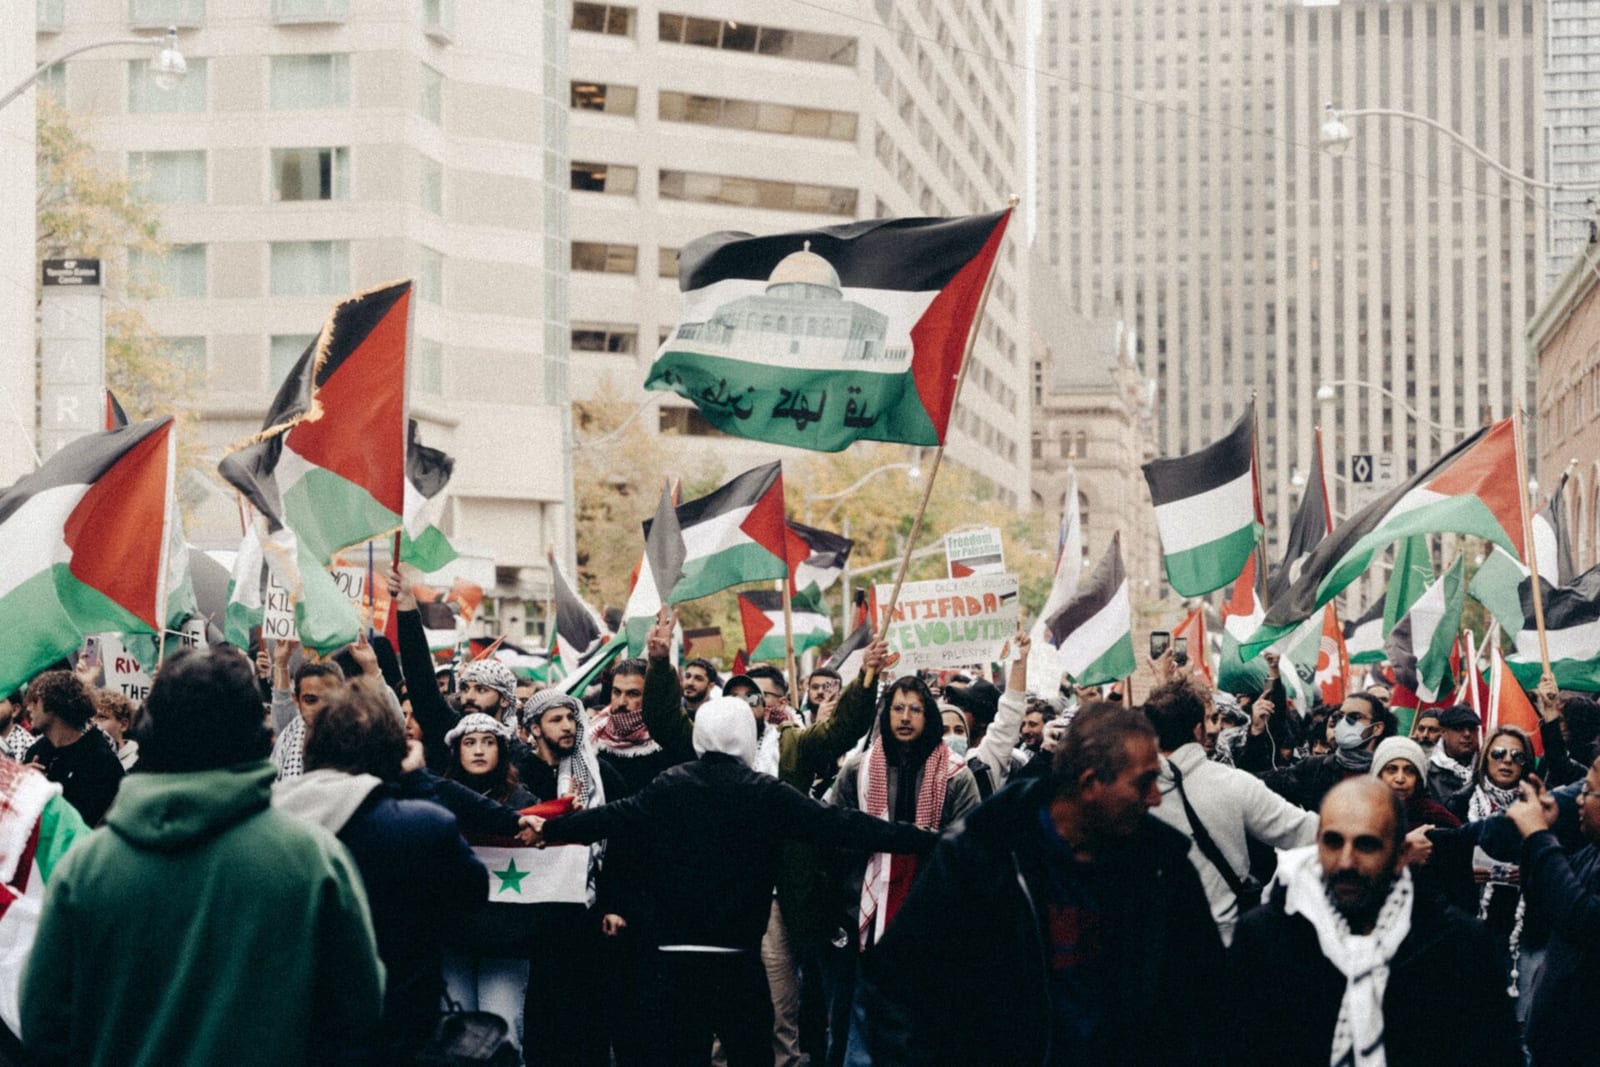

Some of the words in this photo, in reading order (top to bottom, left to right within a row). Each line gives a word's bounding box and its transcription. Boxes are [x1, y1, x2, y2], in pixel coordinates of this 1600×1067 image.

[56, 305, 81, 451] PAR
[268, 592, 293, 613] KIL
[879, 592, 997, 624] INTIFADA
